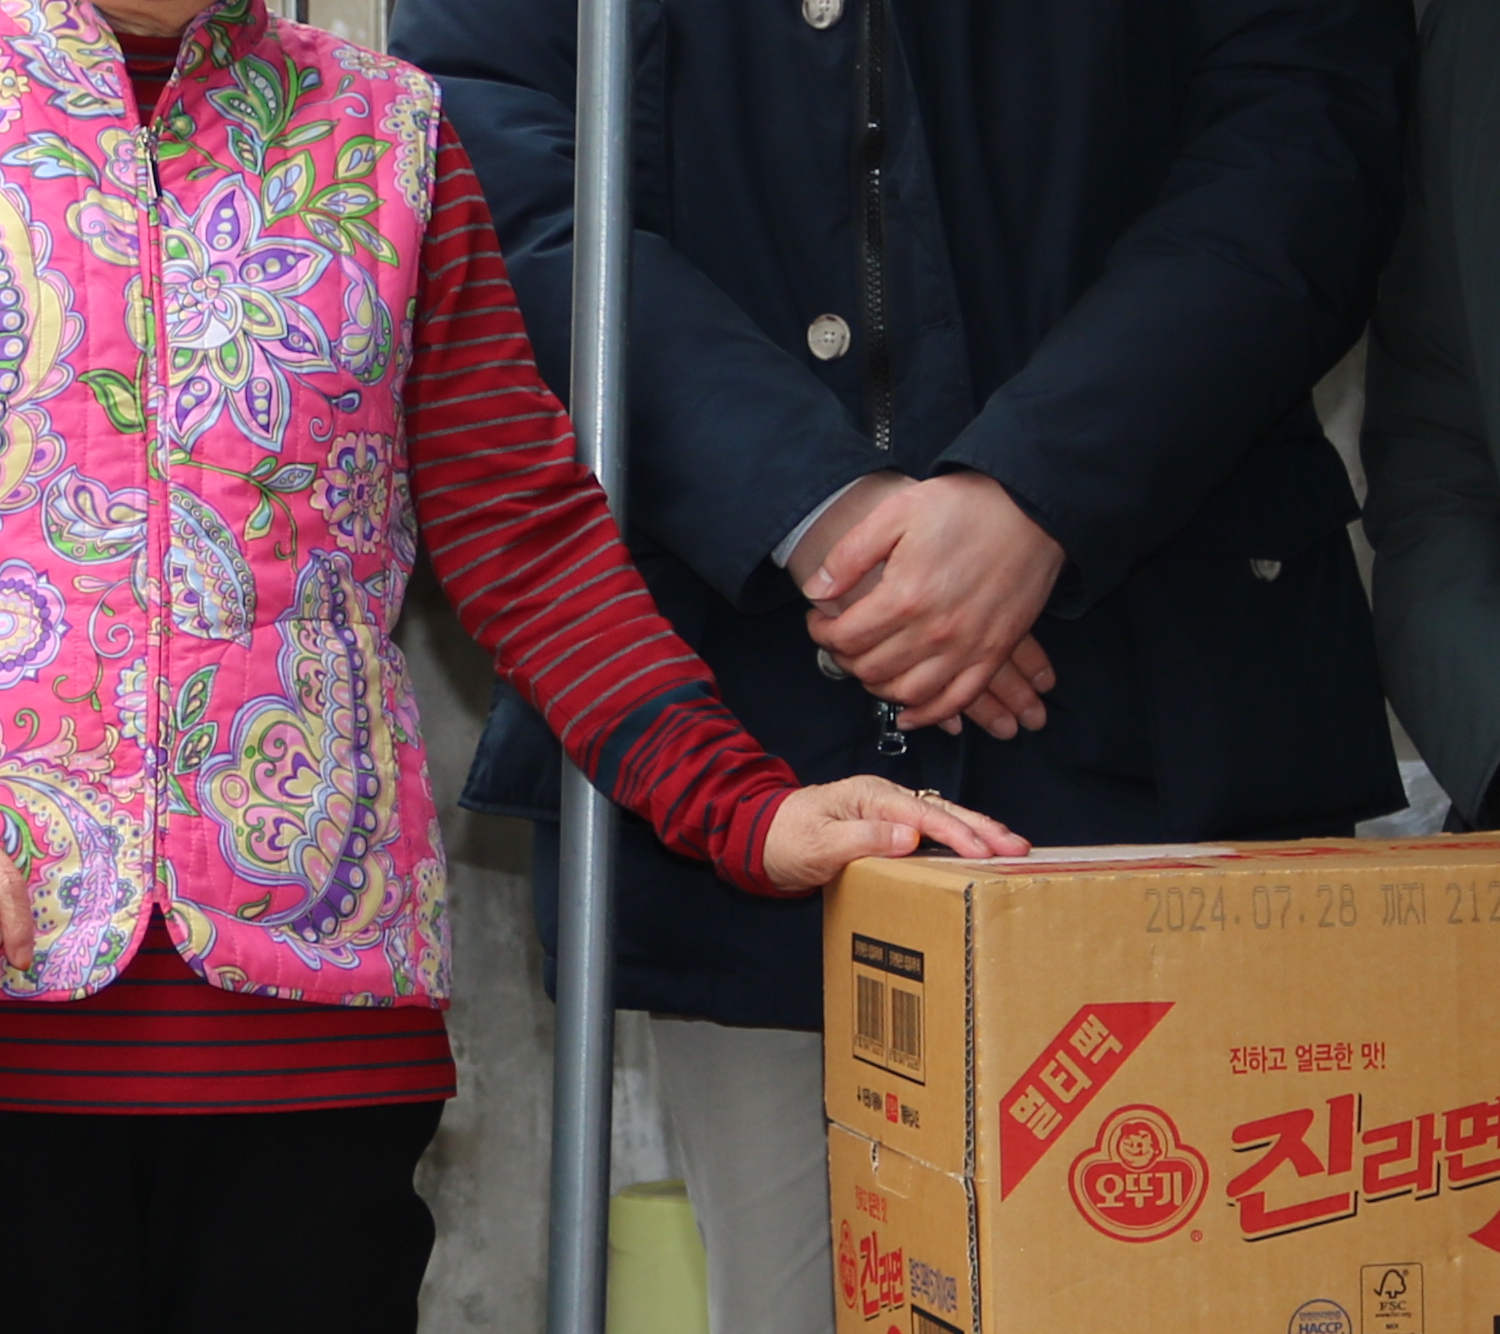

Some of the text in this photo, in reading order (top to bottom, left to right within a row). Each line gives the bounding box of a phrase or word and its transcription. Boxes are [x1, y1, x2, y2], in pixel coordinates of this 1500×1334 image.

[1144, 884, 1357, 933] 2024.07.28
[1011, 1014, 1123, 1138] 멀티팩
[1230, 1042, 1384, 1074] 진하고 얼큰한 맛!
[1095, 1171, 1184, 1210] 오뚜기
[859, 1229, 904, 1322] 진라면
[1297, 1321, 1342, 1334] HACCP
